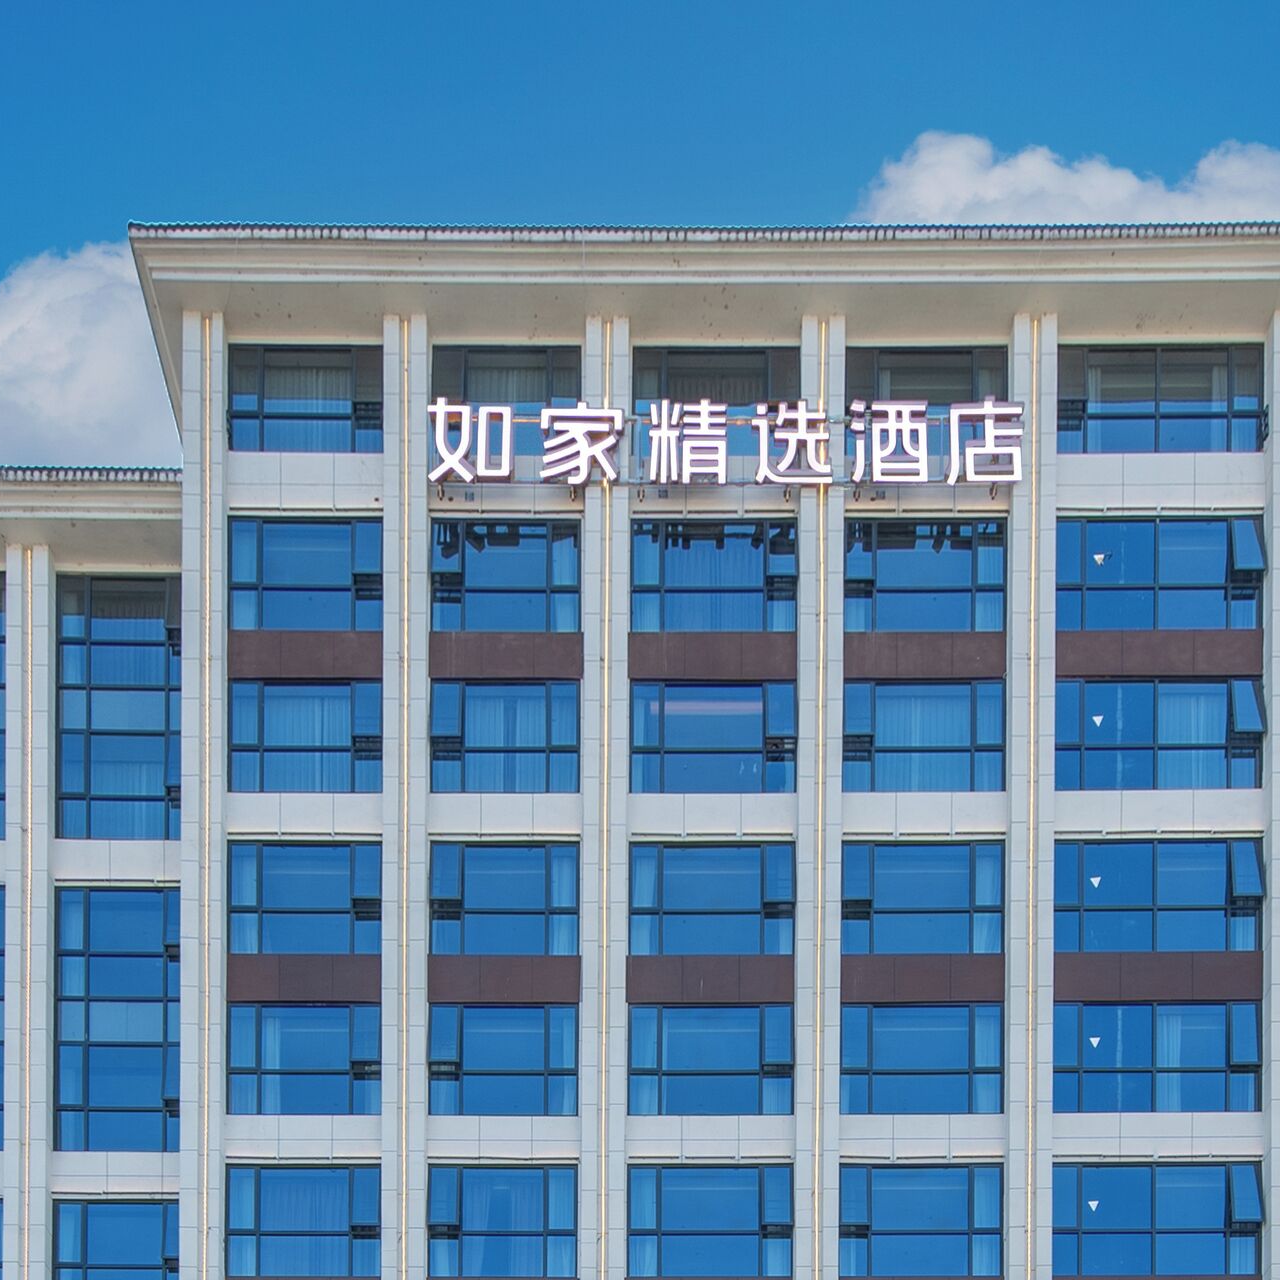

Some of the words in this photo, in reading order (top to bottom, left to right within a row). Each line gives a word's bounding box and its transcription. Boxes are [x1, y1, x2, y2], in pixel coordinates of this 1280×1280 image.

[427, 397, 1024, 485] 如家精选酒店
